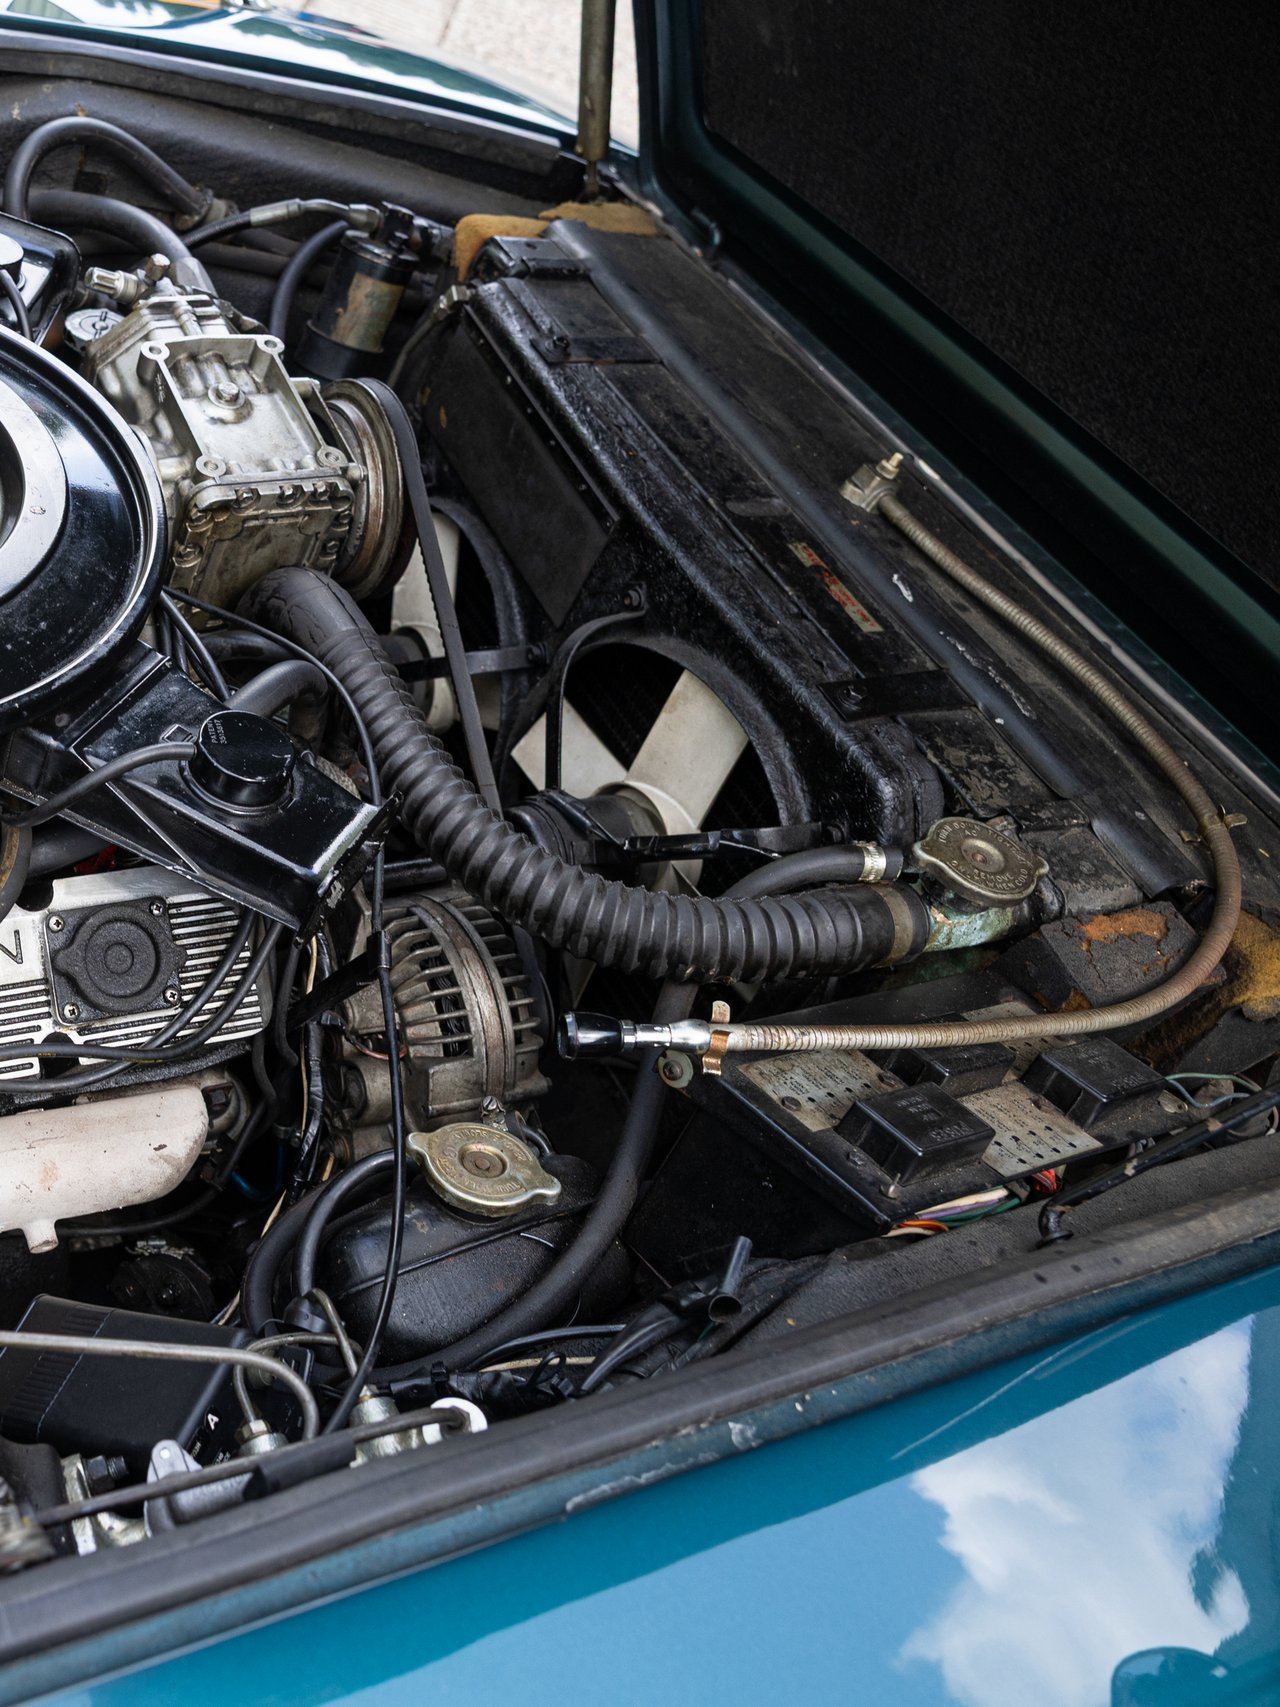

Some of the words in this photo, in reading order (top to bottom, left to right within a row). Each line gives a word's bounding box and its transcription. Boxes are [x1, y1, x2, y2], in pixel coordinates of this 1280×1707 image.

[938, 825, 953, 843] TURN
[972, 868, 1014, 883] REMOVE
[1015, 868, 1028, 886] COLD
